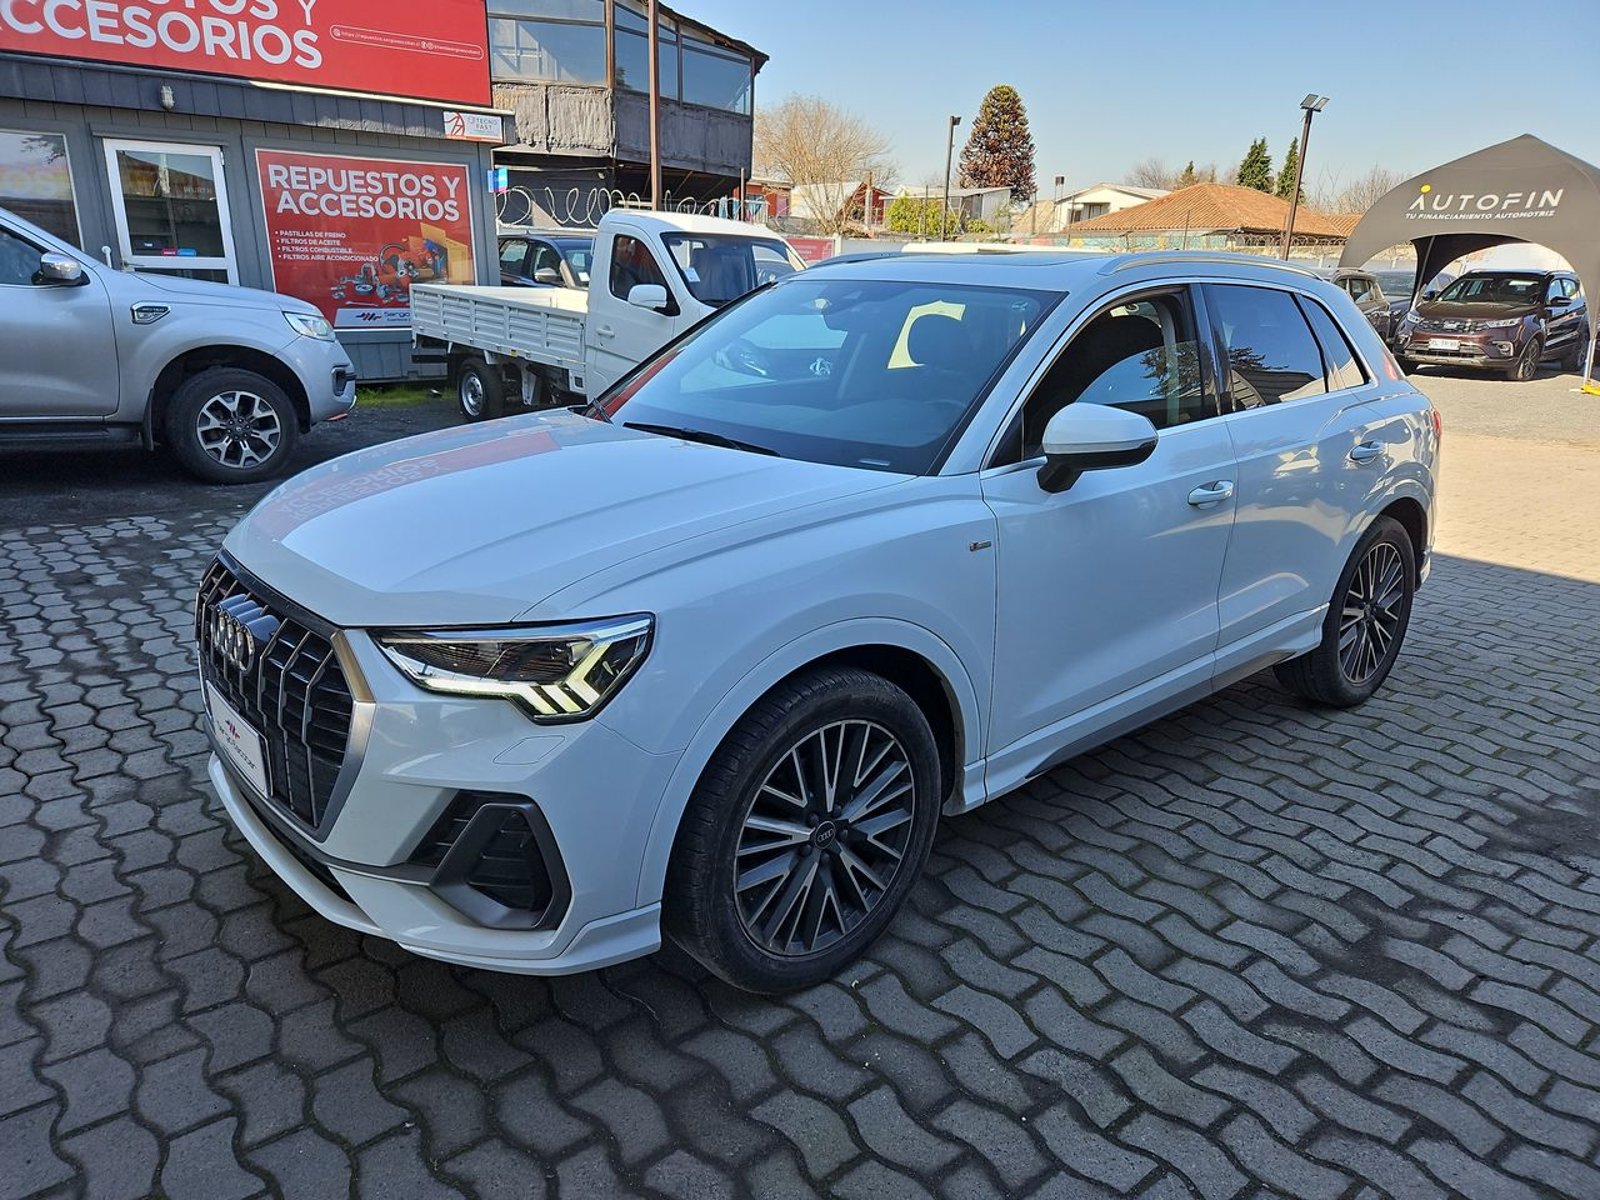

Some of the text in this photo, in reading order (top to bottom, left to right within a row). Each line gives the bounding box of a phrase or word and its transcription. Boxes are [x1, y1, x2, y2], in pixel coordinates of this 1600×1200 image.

[0, 0, 322, 69] CCESORIOS
[268, 164, 460, 198] REPUESTOS Y
[277, 191, 460, 221] ACCESORIOS
[1409, 187, 1564, 211] AUTOFIN
[1495, 210, 1556, 219] AUTOMOTRIZ
